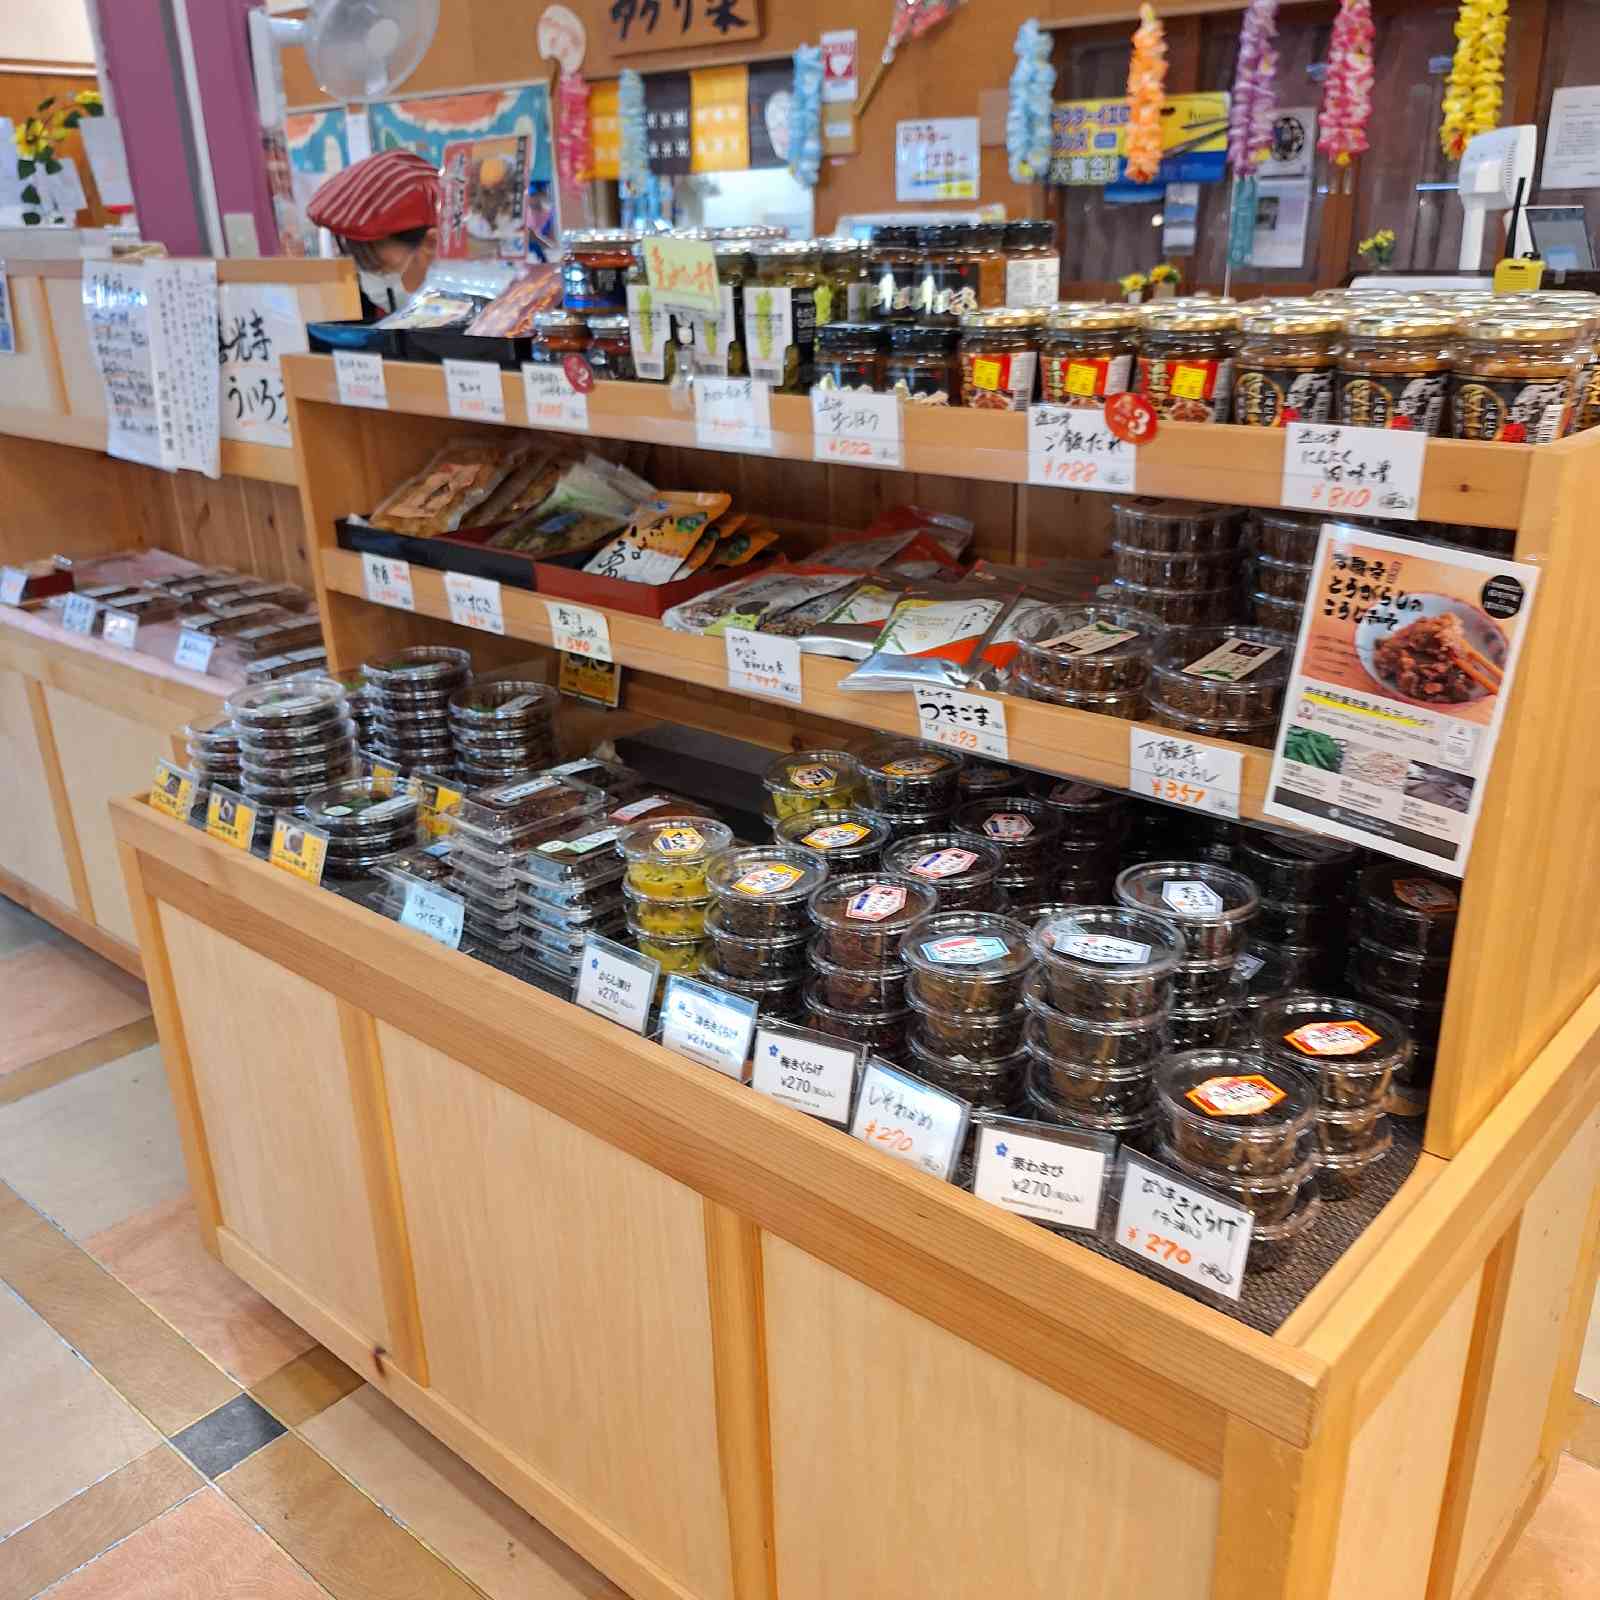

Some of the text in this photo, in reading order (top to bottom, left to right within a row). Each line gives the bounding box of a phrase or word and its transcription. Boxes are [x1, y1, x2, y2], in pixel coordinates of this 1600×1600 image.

[919, 702, 989, 727] つきごま
[598, 986, 619, 1004] ¥270
[781, 1075, 811, 1094] ¥270
[864, 1119, 914, 1152] ¥270
[1012, 1178, 1052, 1199] ¥270
[1127, 1225, 1192, 1265] ¥270
